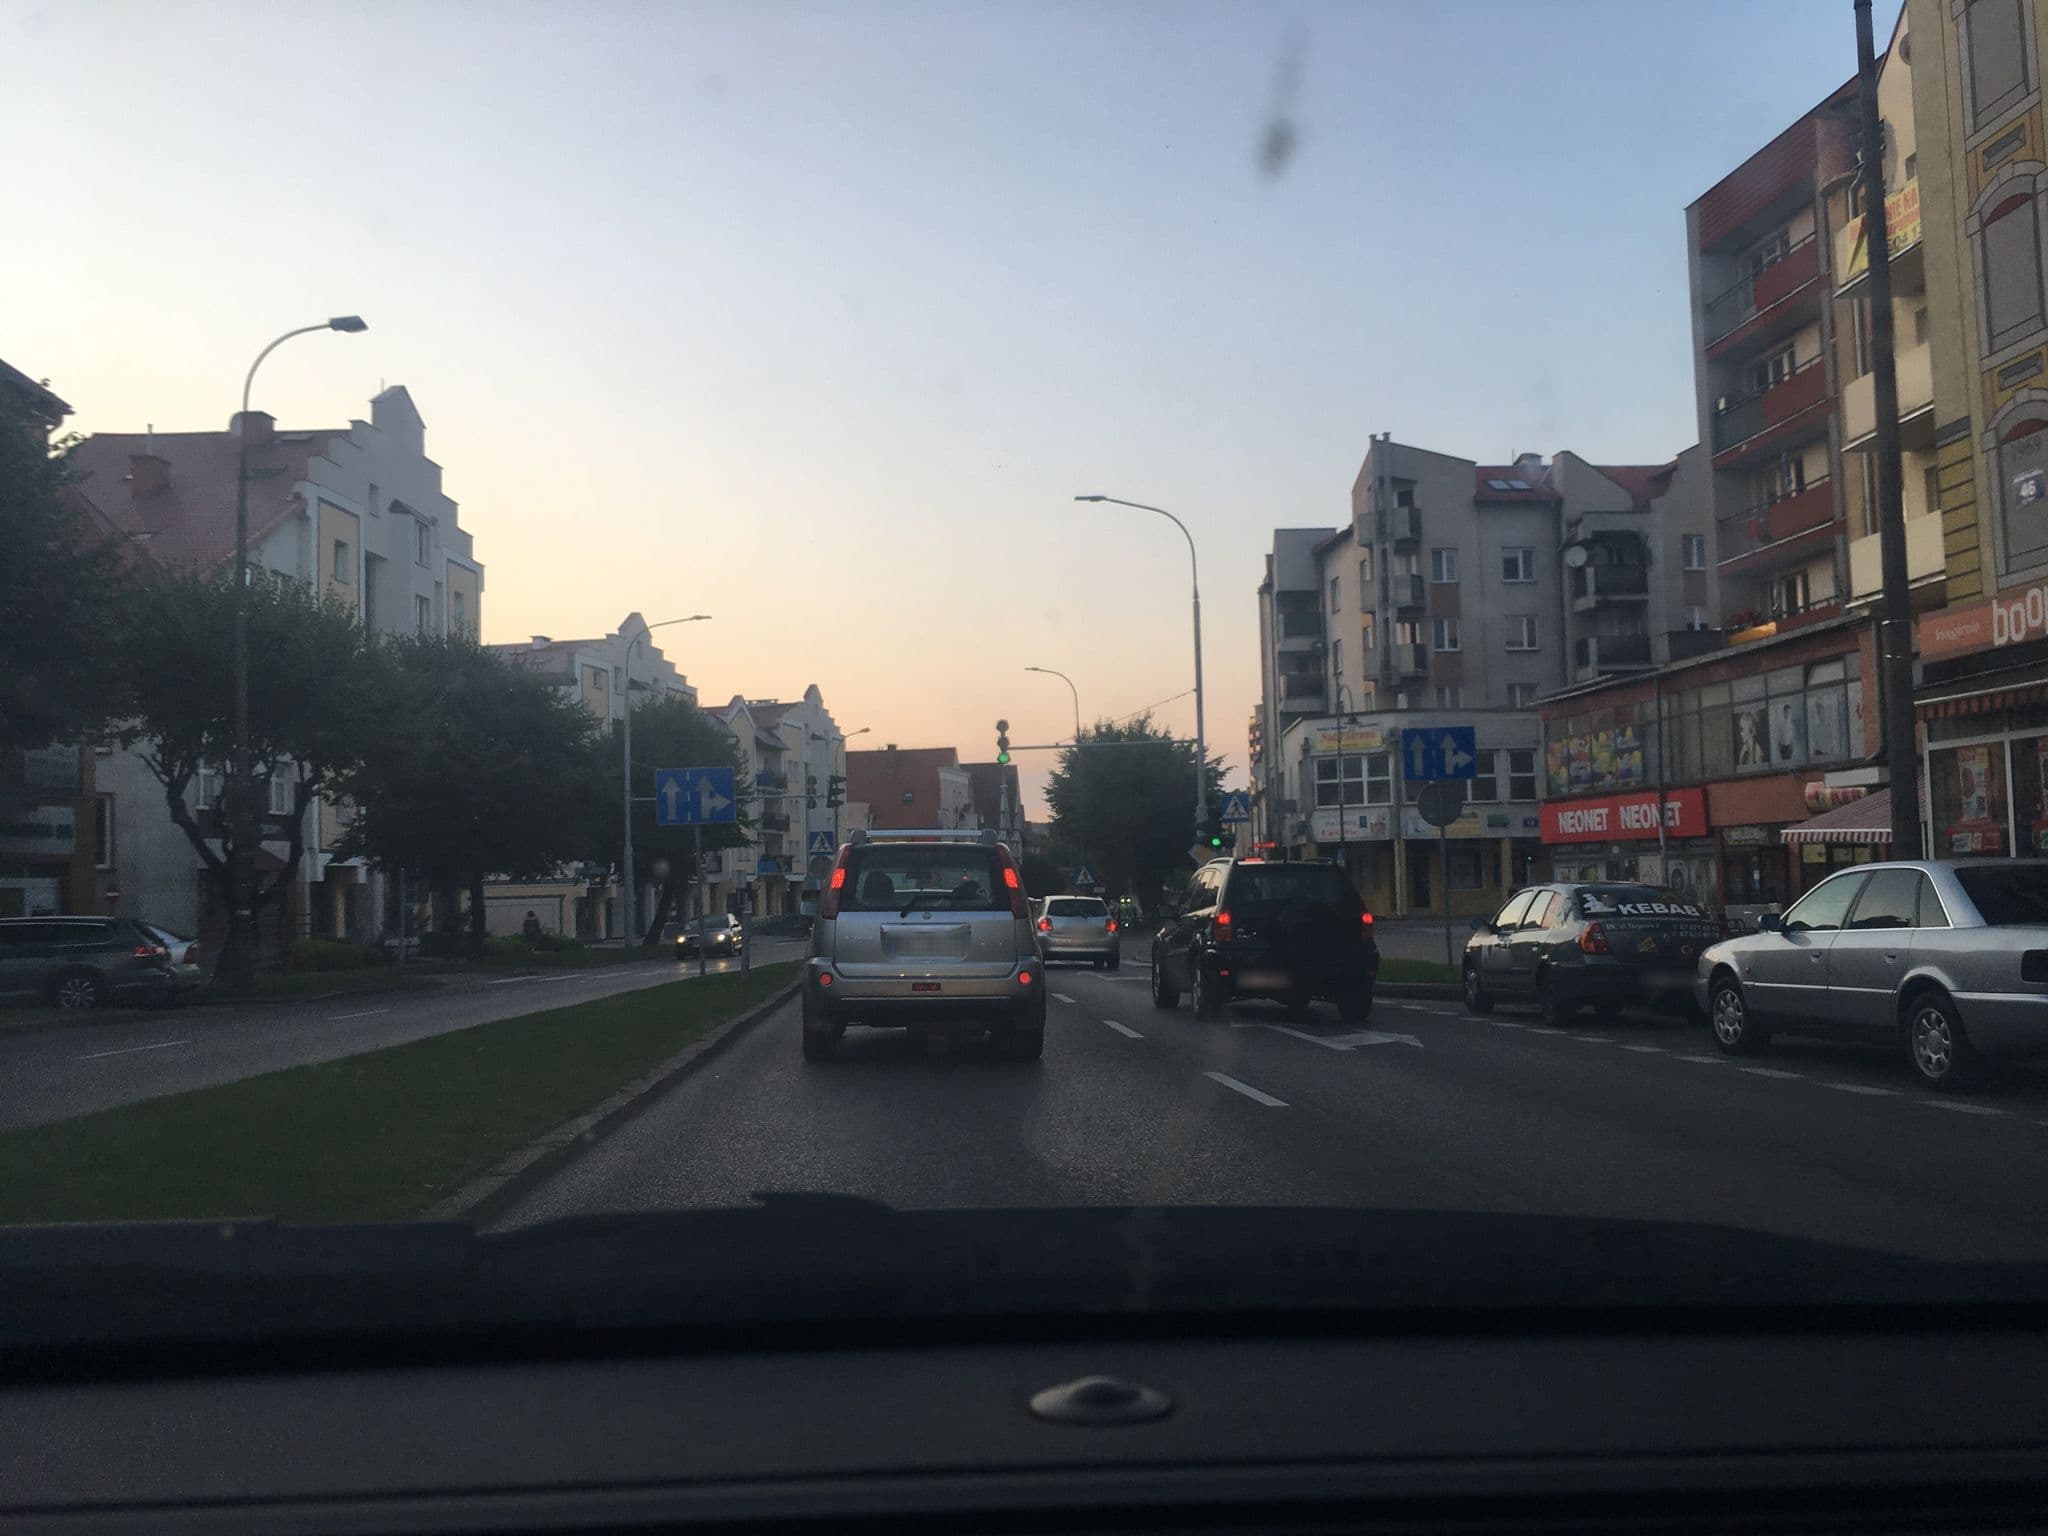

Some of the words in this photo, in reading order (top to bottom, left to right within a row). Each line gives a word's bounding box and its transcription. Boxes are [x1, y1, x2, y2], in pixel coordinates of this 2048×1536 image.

[2020, 480, 2037, 497] 46
[1992, 585, 2048, 646] boo
[1558, 807, 1609, 834] NEONET
[1619, 801, 1682, 830] NEONET
[1618, 902, 1701, 917] KEBAB
